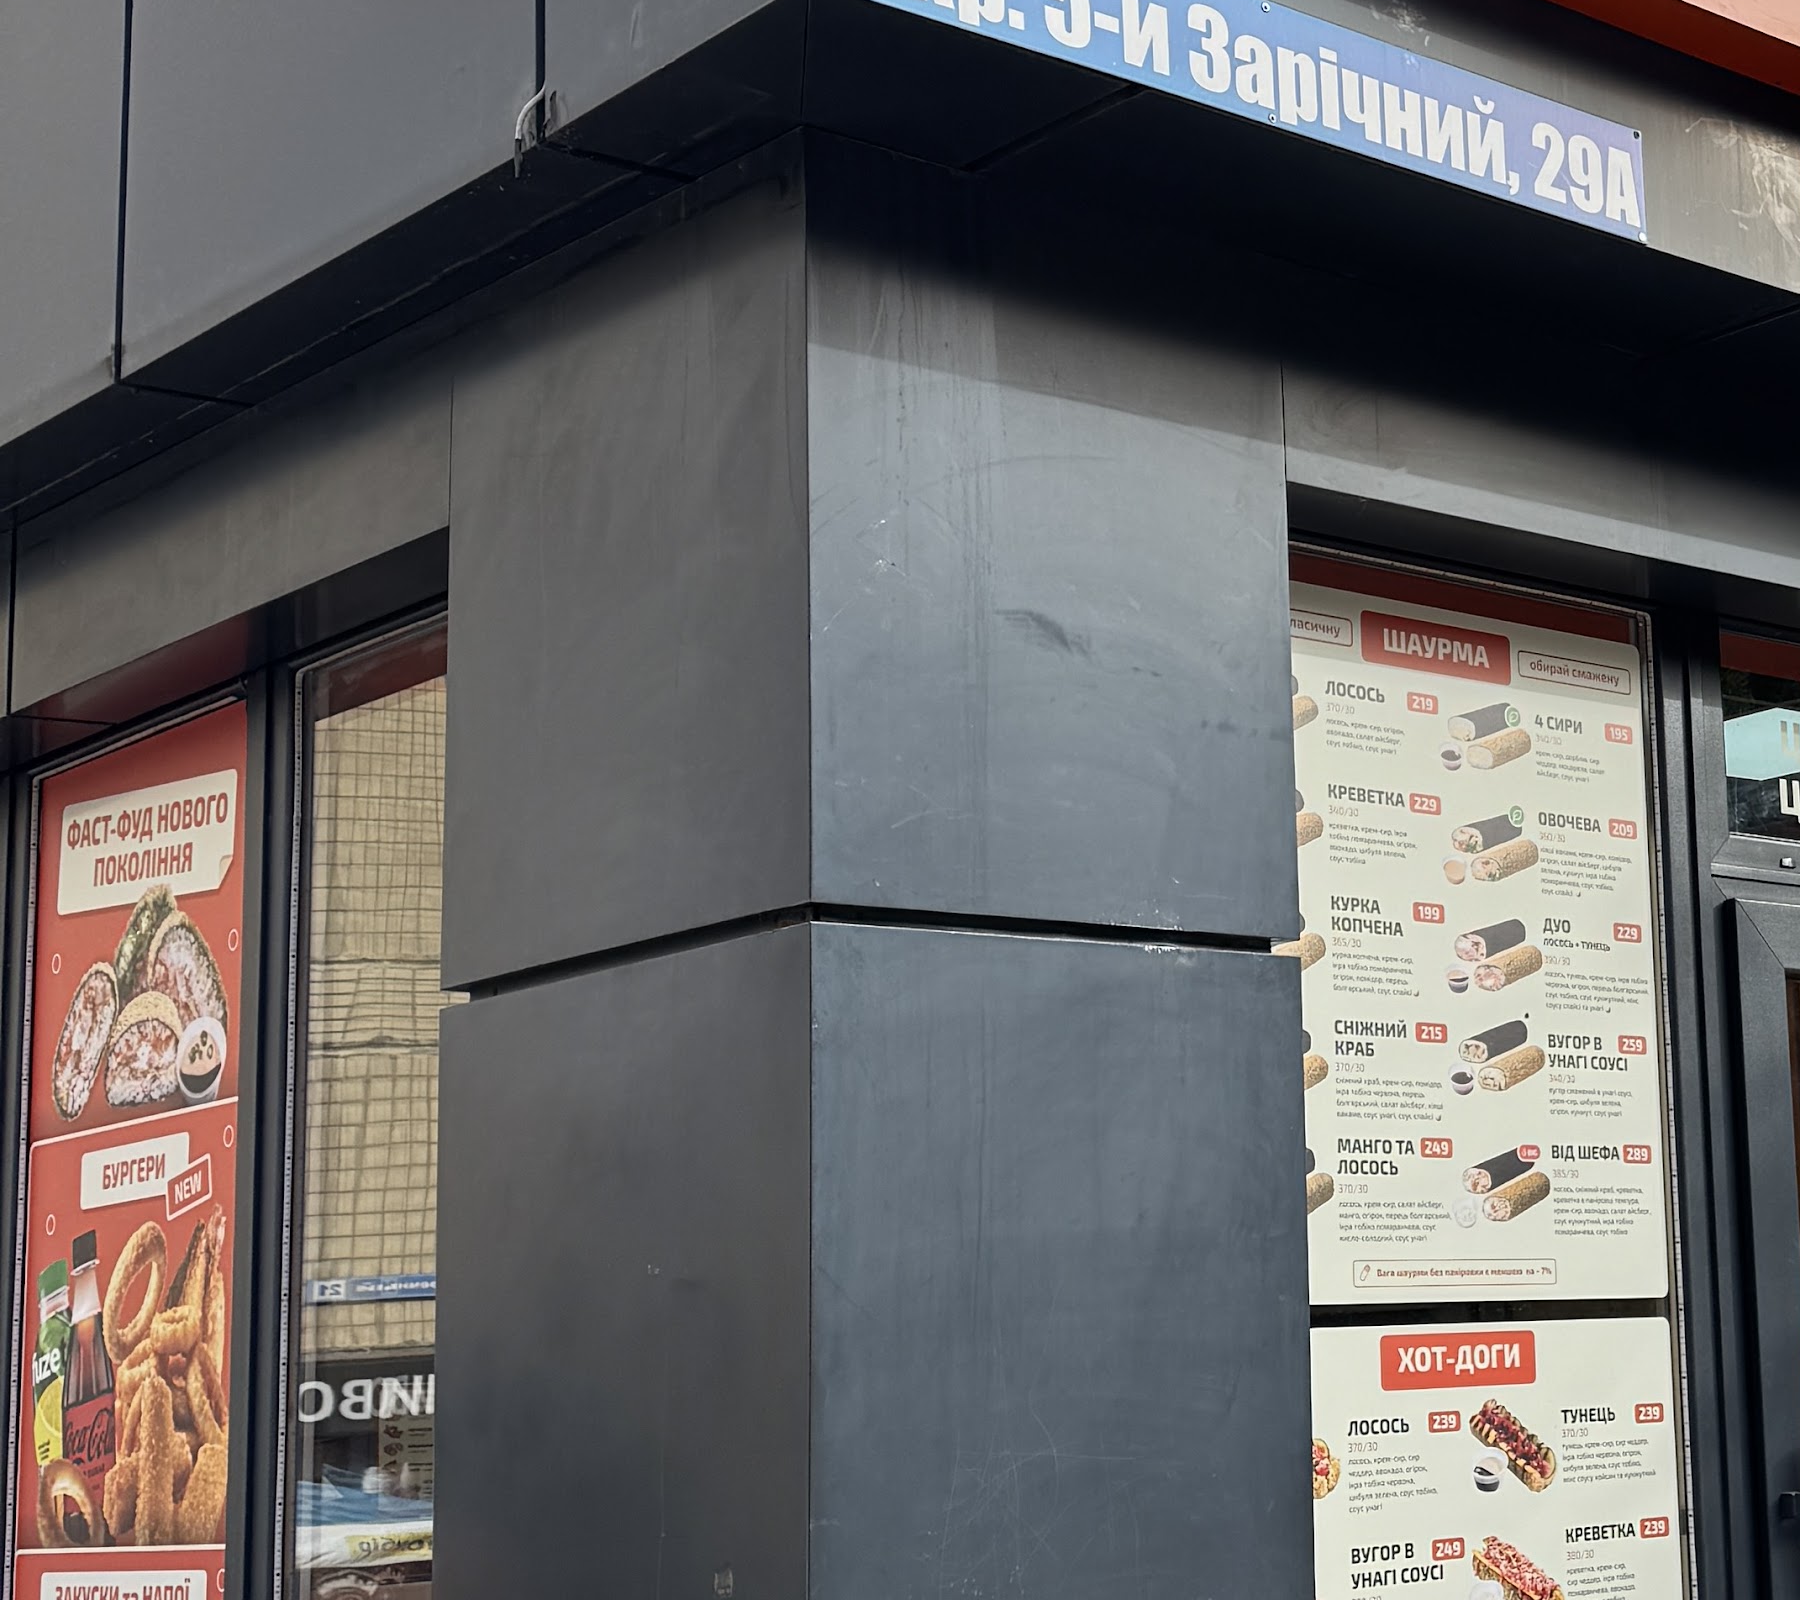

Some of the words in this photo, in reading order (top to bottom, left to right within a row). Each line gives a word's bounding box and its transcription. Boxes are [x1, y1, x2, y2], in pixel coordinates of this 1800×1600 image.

[1188, 1, 1520, 197] Зарічний,
[1534, 122, 1642, 228] 29А
[1383, 628, 1489, 668] ШАУРМА
[1530, 659, 1569, 679] обирай
[1571, 667, 1619, 687] смажену
[1325, 680, 1385, 703] ЛОСОСЬ
[1412, 695, 1433, 711] 219
[1535, 716, 1543, 729] 4
[1546, 716, 1582, 734] СИРИ
[1609, 728, 1628, 741] 195
[1328, 784, 1405, 808] КРЕВЕТКА
[1414, 797, 1436, 812] 229
[68, 808, 153, 850] ФАСТ-ФУД
[158, 792, 228, 832] НОВОГО
[1539, 812, 1601, 833] ОВОЧЕВА
[1612, 824, 1633, 838] 209
[93, 842, 193, 887] ПОКОЛІННЯ
[1331, 895, 1380, 914] КУРКА
[1418, 906, 1439, 920] 199
[1331, 916, 1403, 937] КОПЧЕНА
[1543, 918, 1571, 935] ДУО
[1617, 926, 1637, 940] 229
[1334, 1019, 1407, 1039] СНІЖНИЙ
[1421, 1026, 1442, 1040] 215
[1335, 1040, 1375, 1057] КРАБ
[1548, 1034, 1588, 1052] ВУГОР
[1593, 1036, 1602, 1051] В
[1622, 1038, 1643, 1052] 259
[1548, 1054, 1588, 1071] УНАГІ
[1590, 1055, 1628, 1072] СОУСІ
[1337, 1138, 1392, 1156] МАНГО
[1396, 1139, 1415, 1156] ТА
[1424, 1140, 1449, 1155] 249
[1551, 1145, 1576, 1161] ВІД
[1578, 1145, 1620, 1162] ШЕФА
[1627, 1147, 1647, 1162] 289
[102, 1153, 166, 1190] БУРГЕРИ
[1337, 1158, 1398, 1176] ЛОСОСЬ
[174, 1173, 201, 1204] NEW
[1398, 1343, 1520, 1376] ХОТ-ДОГИ
[1348, 1418, 1409, 1436] ЛОСОСЬ
[1432, 1415, 1457, 1429] 239
[1561, 1407, 1616, 1425] ТУНЕЦЬ
[1638, 1407, 1660, 1420] 239
[1566, 1522, 1635, 1543] КРЕВЕТКА
[1643, 1520, 1666, 1534] 239
[1352, 1543, 1402, 1564] ВУГОР
[1405, 1543, 1414, 1559] В
[1435, 1542, 1461, 1557] 249
[1352, 1566, 1398, 1590] УНАГІ
[1401, 1564, 1444, 1585] СОУСІ
